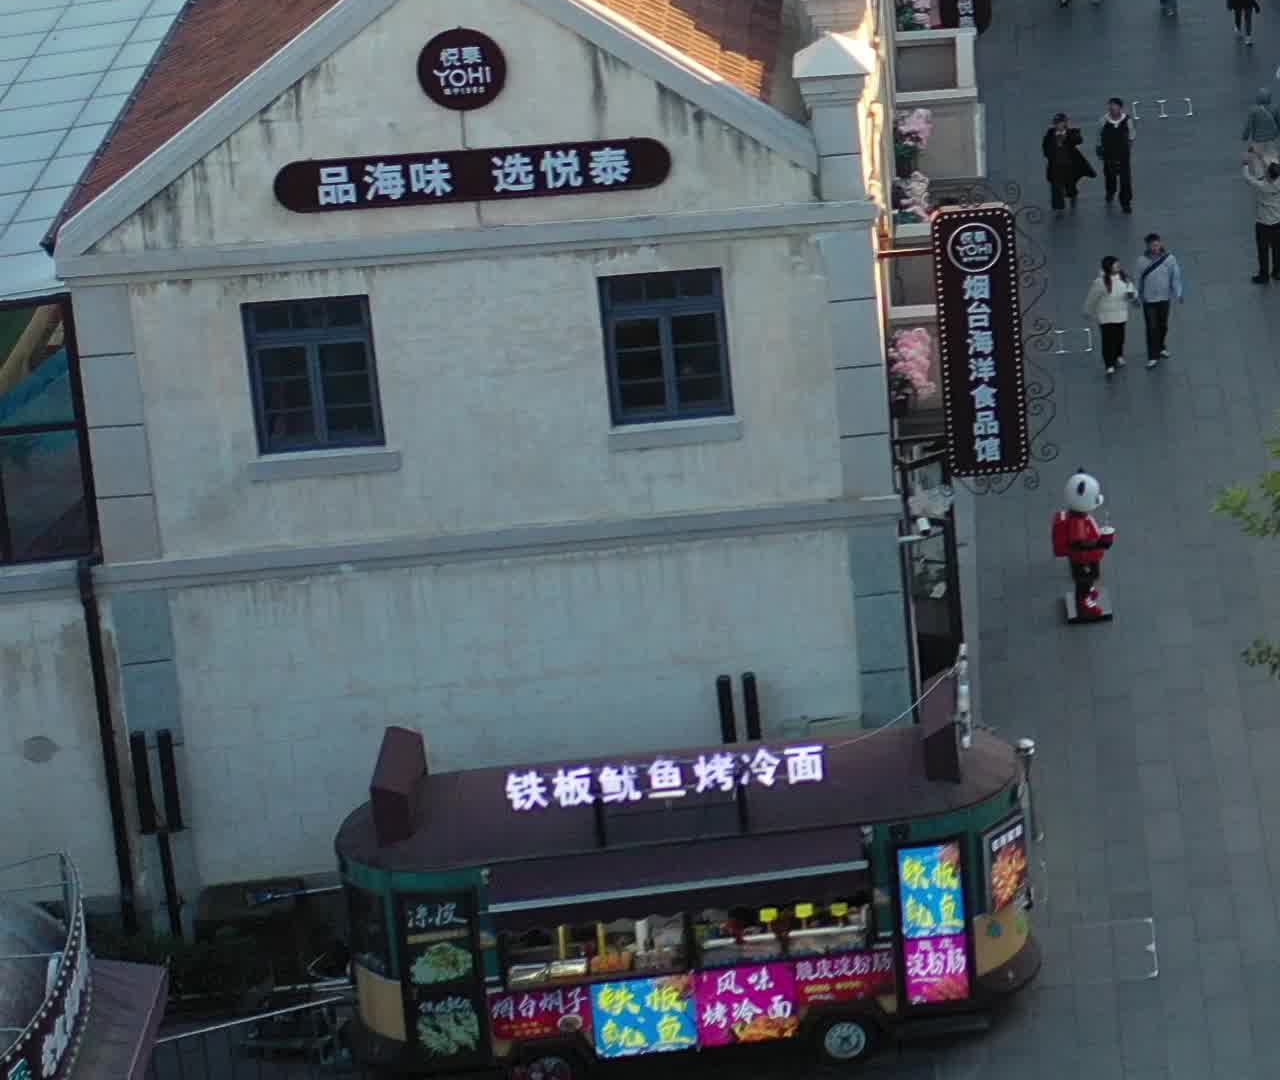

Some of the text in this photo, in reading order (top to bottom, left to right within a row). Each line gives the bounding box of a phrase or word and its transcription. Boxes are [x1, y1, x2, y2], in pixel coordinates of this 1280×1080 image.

[317, 146, 632, 206] 品海味 选悦泰
[962, 274, 1001, 463] 烟台海洋食品馆
[505, 744, 825, 811] 铁板鱿鱼烤冷面
[903, 856, 961, 889] 铁板
[905, 893, 965, 928] 鱿鱼
[907, 948, 967, 977] 淀粉肠
[599, 983, 688, 1015] 铁板
[716, 967, 775, 996] 风味
[703, 994, 792, 1029] 烤冷面
[602, 1014, 697, 1050] 鱿鱼
